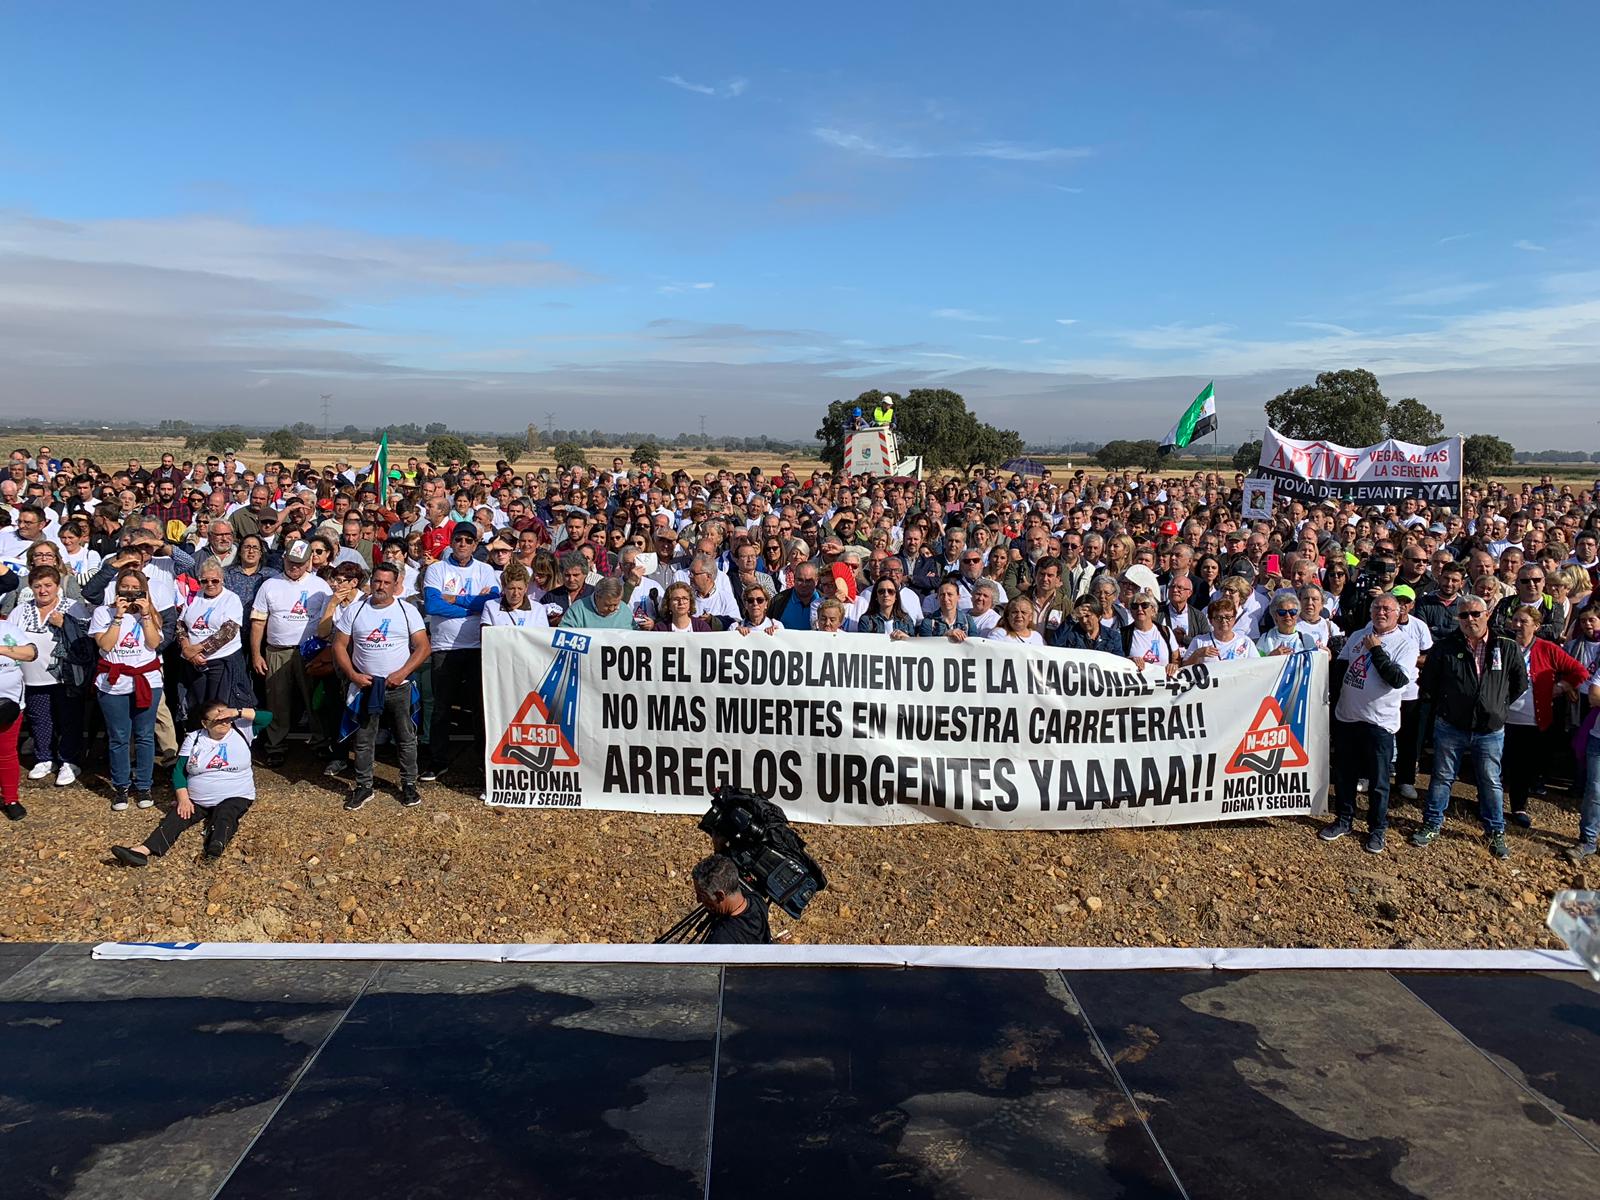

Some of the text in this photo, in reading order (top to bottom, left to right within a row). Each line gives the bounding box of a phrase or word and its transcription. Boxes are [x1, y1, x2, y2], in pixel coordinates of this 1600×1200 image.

[1270, 444, 1359, 480] APYME
[1369, 449, 1448, 465] VEGAS ALTAS
[1374, 465, 1439, 478] LA SERENA
[1319, 485, 1343, 499] DEL
[1350, 486, 1414, 499] LEVANTE
[1417, 484, 1458, 500] ¡YA!
[555, 632, 587, 651] A-43
[601, 645, 652, 683] POR
[662, 647, 691, 684] EL
[700, 648, 935, 693] DESDOBLAMIENTO
[943, 657, 977, 694] DE
[985, 657, 1018, 695] LA
[602, 693, 1206, 744] NO MAS MUERTES EN NUESTRA CARRETERA!!
[511, 726, 558, 744] N-430
[1246, 728, 1287, 751] N-430
[492, 769, 582, 792] NACIONAL
[602, 744, 1217, 812] ARREGLOS URGENTES YAAAAA!!
[1223, 771, 1311, 800] NACIONAL
[491, 791, 582, 807] DIGNA Y SEGURA
[1221, 794, 1312, 813] DIGNA Y SEGURA
